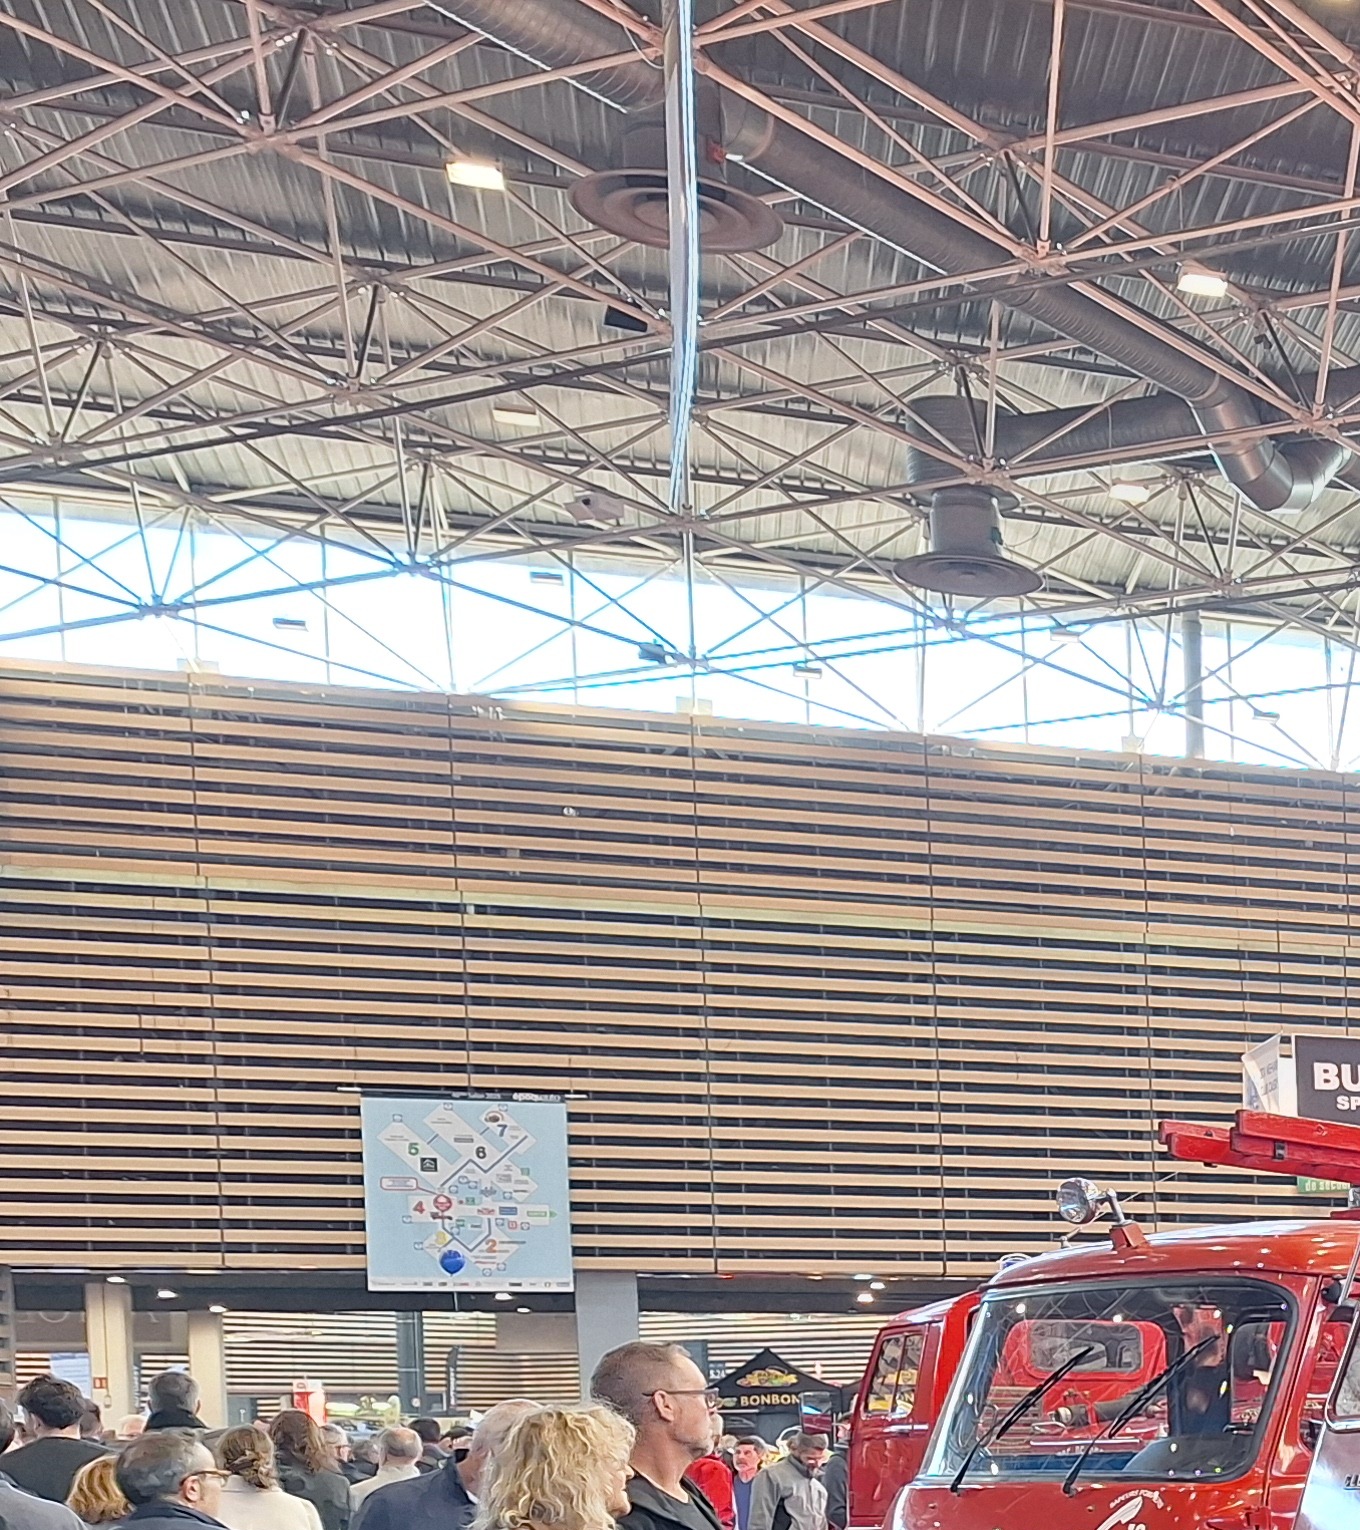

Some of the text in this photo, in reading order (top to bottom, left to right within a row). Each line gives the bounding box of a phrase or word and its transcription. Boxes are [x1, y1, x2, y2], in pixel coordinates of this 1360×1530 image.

[497, 1124, 507, 1137] 7
[408, 1142, 419, 1156] 5
[475, 1146, 487, 1159] 6
[412, 1200, 425, 1214] 4
[485, 1238, 497, 1253] 2
